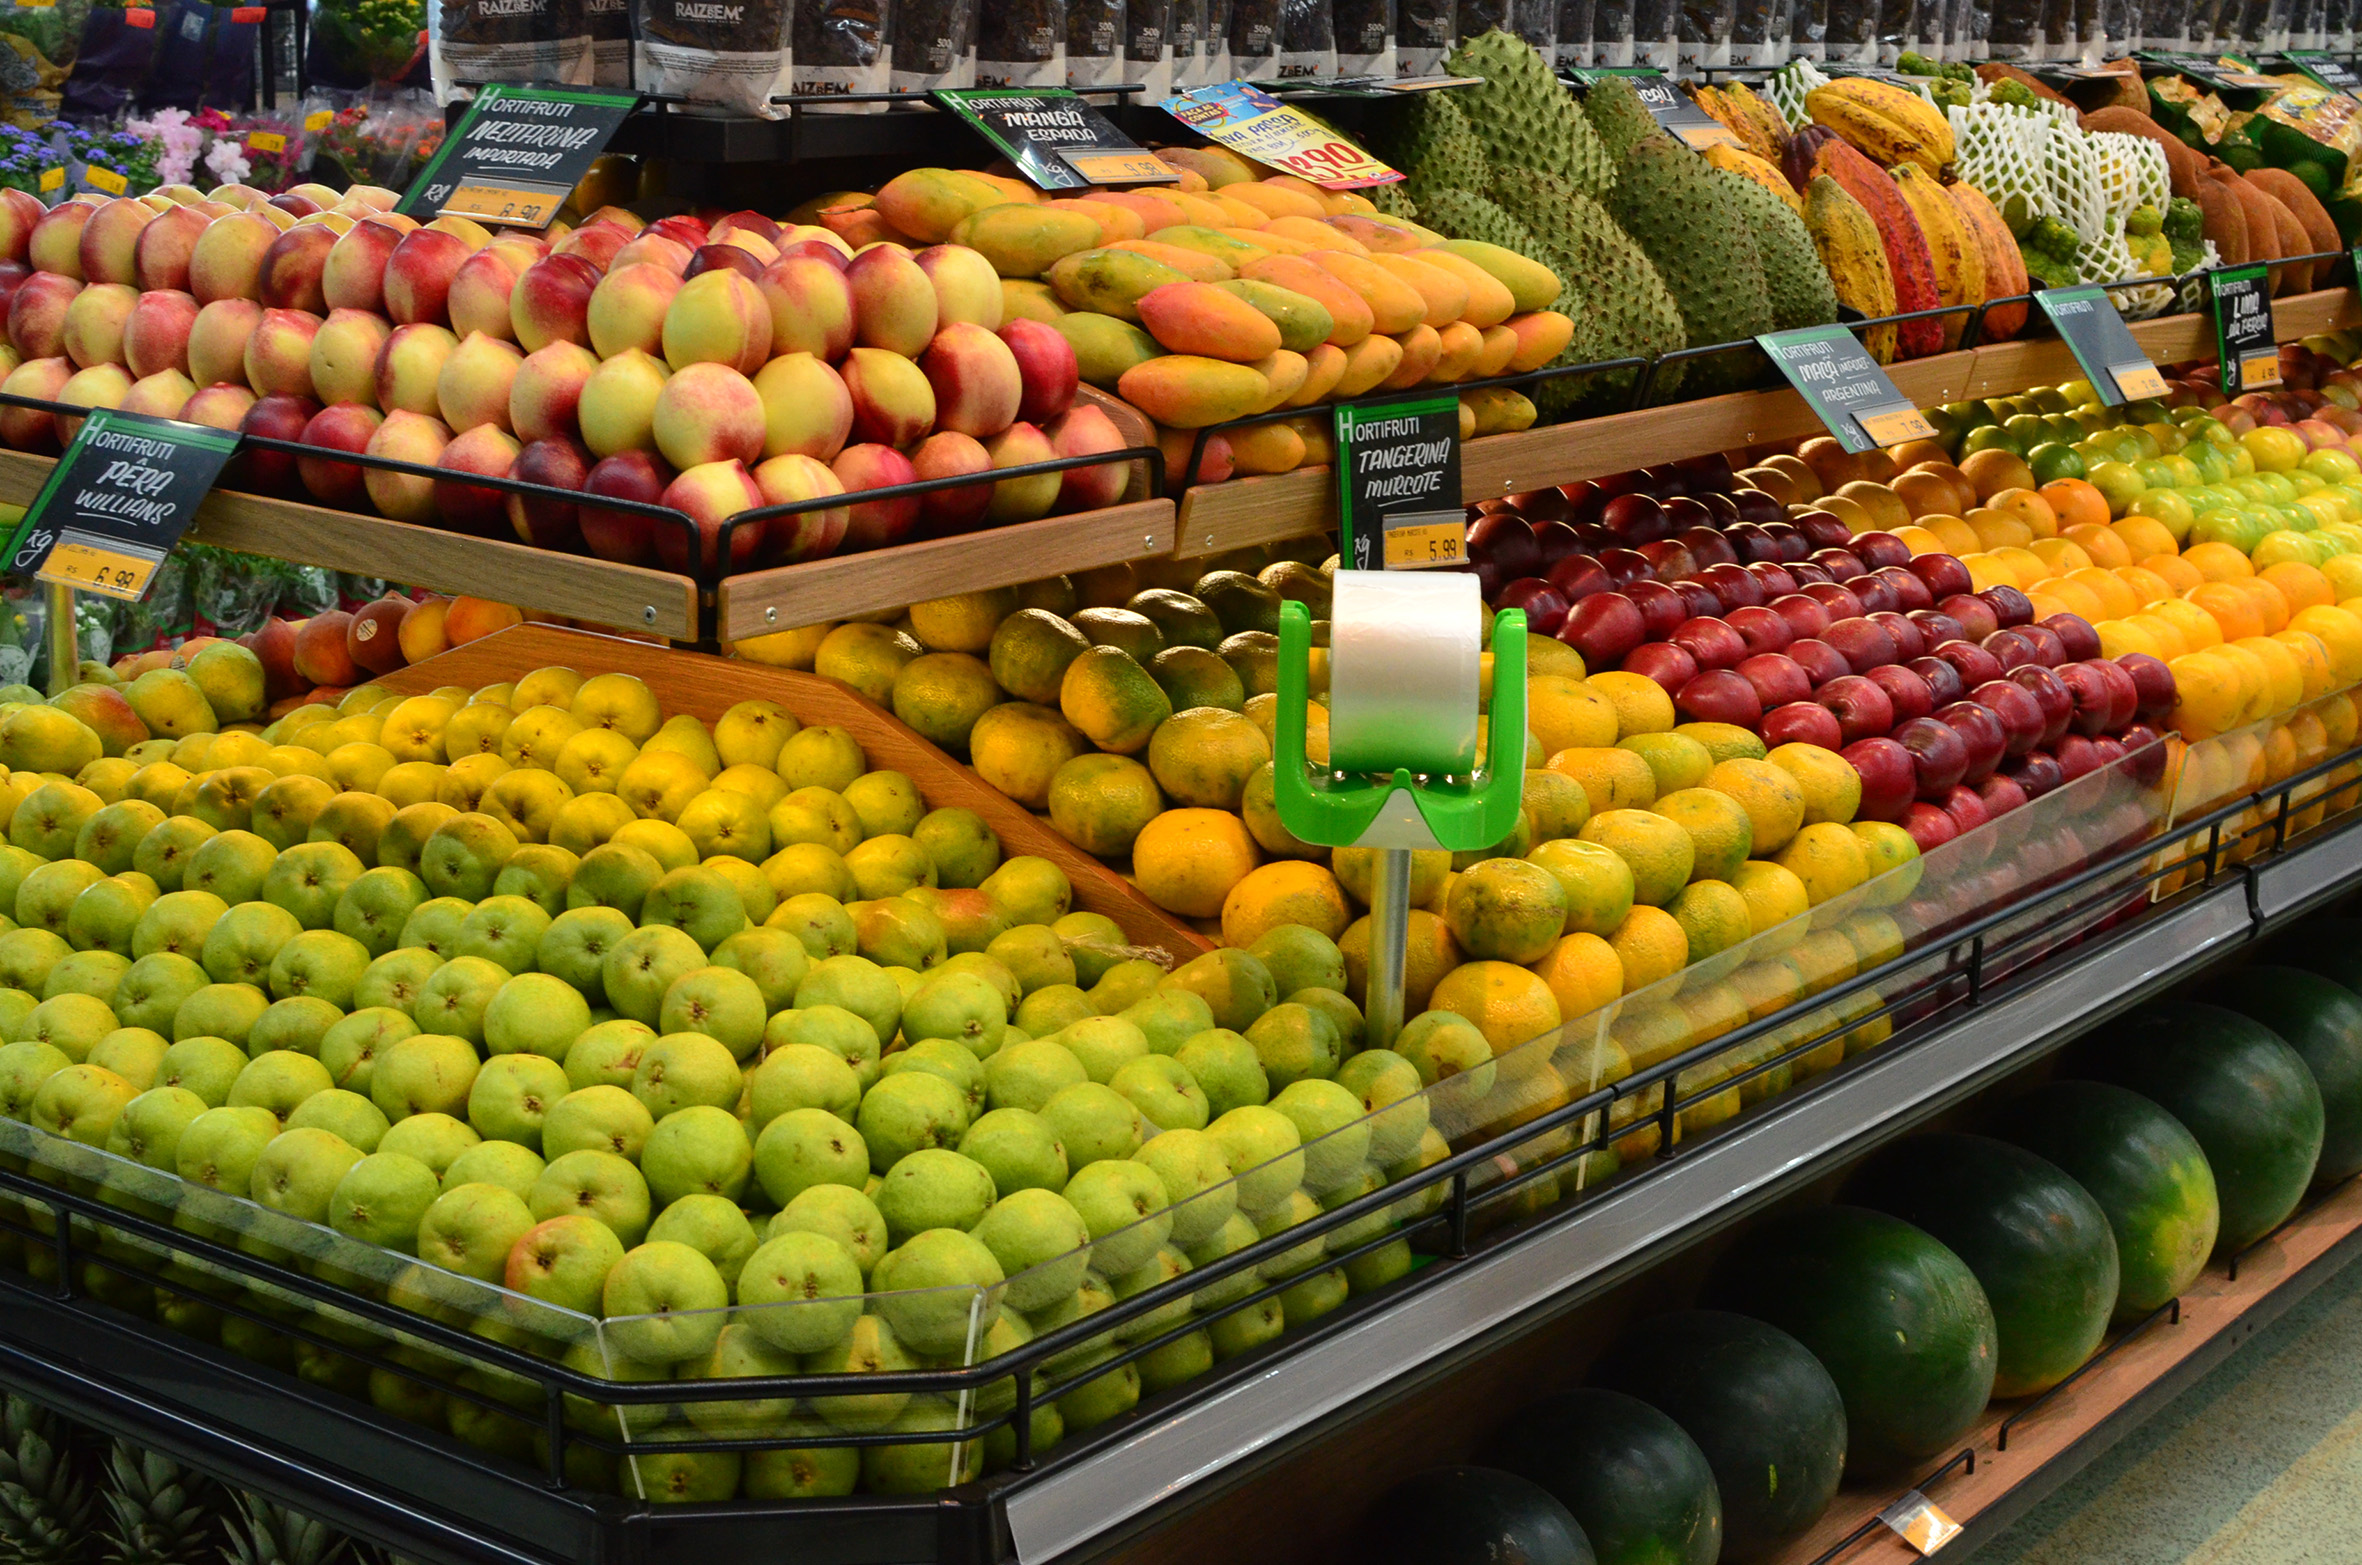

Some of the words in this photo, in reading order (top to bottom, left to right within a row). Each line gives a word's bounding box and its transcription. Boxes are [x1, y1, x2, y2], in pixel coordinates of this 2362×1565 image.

[472, 87, 575, 118] HORTIFRUTI
[941, 92, 1046, 111] HORTIFRUTI
[1005, 108, 1085, 128] MANGA
[1247, 114, 1299, 137] PASSA
[467, 120, 599, 150] NECTARINA
[1026, 128, 1098, 142] ESPADA
[463, 146, 563, 170] IMPORTADA
[2211, 276, 2251, 297] HORTIFRUTI
[2038, 295, 2095, 317] HORTIFRUTI
[1762, 339, 1835, 361] HORTIFRUTI
[1798, 355, 1840, 384] MAÇÃ
[1821, 380, 1883, 403] ARGENTINA
[77, 415, 176, 461] HORTIFRUTI
[1338, 411, 1420, 444] HORTIFRUTI
[1358, 436, 1452, 474] TANGERINA
[95, 458, 175, 497] PÊRA
[1364, 470, 1444, 500] MURCOTE
[74, 488, 177, 525] WILLIANS
[15, 528, 54, 568] Kg
[1429, 538, 1457, 562] 5.99
[93, 566, 135, 592] 6.98
